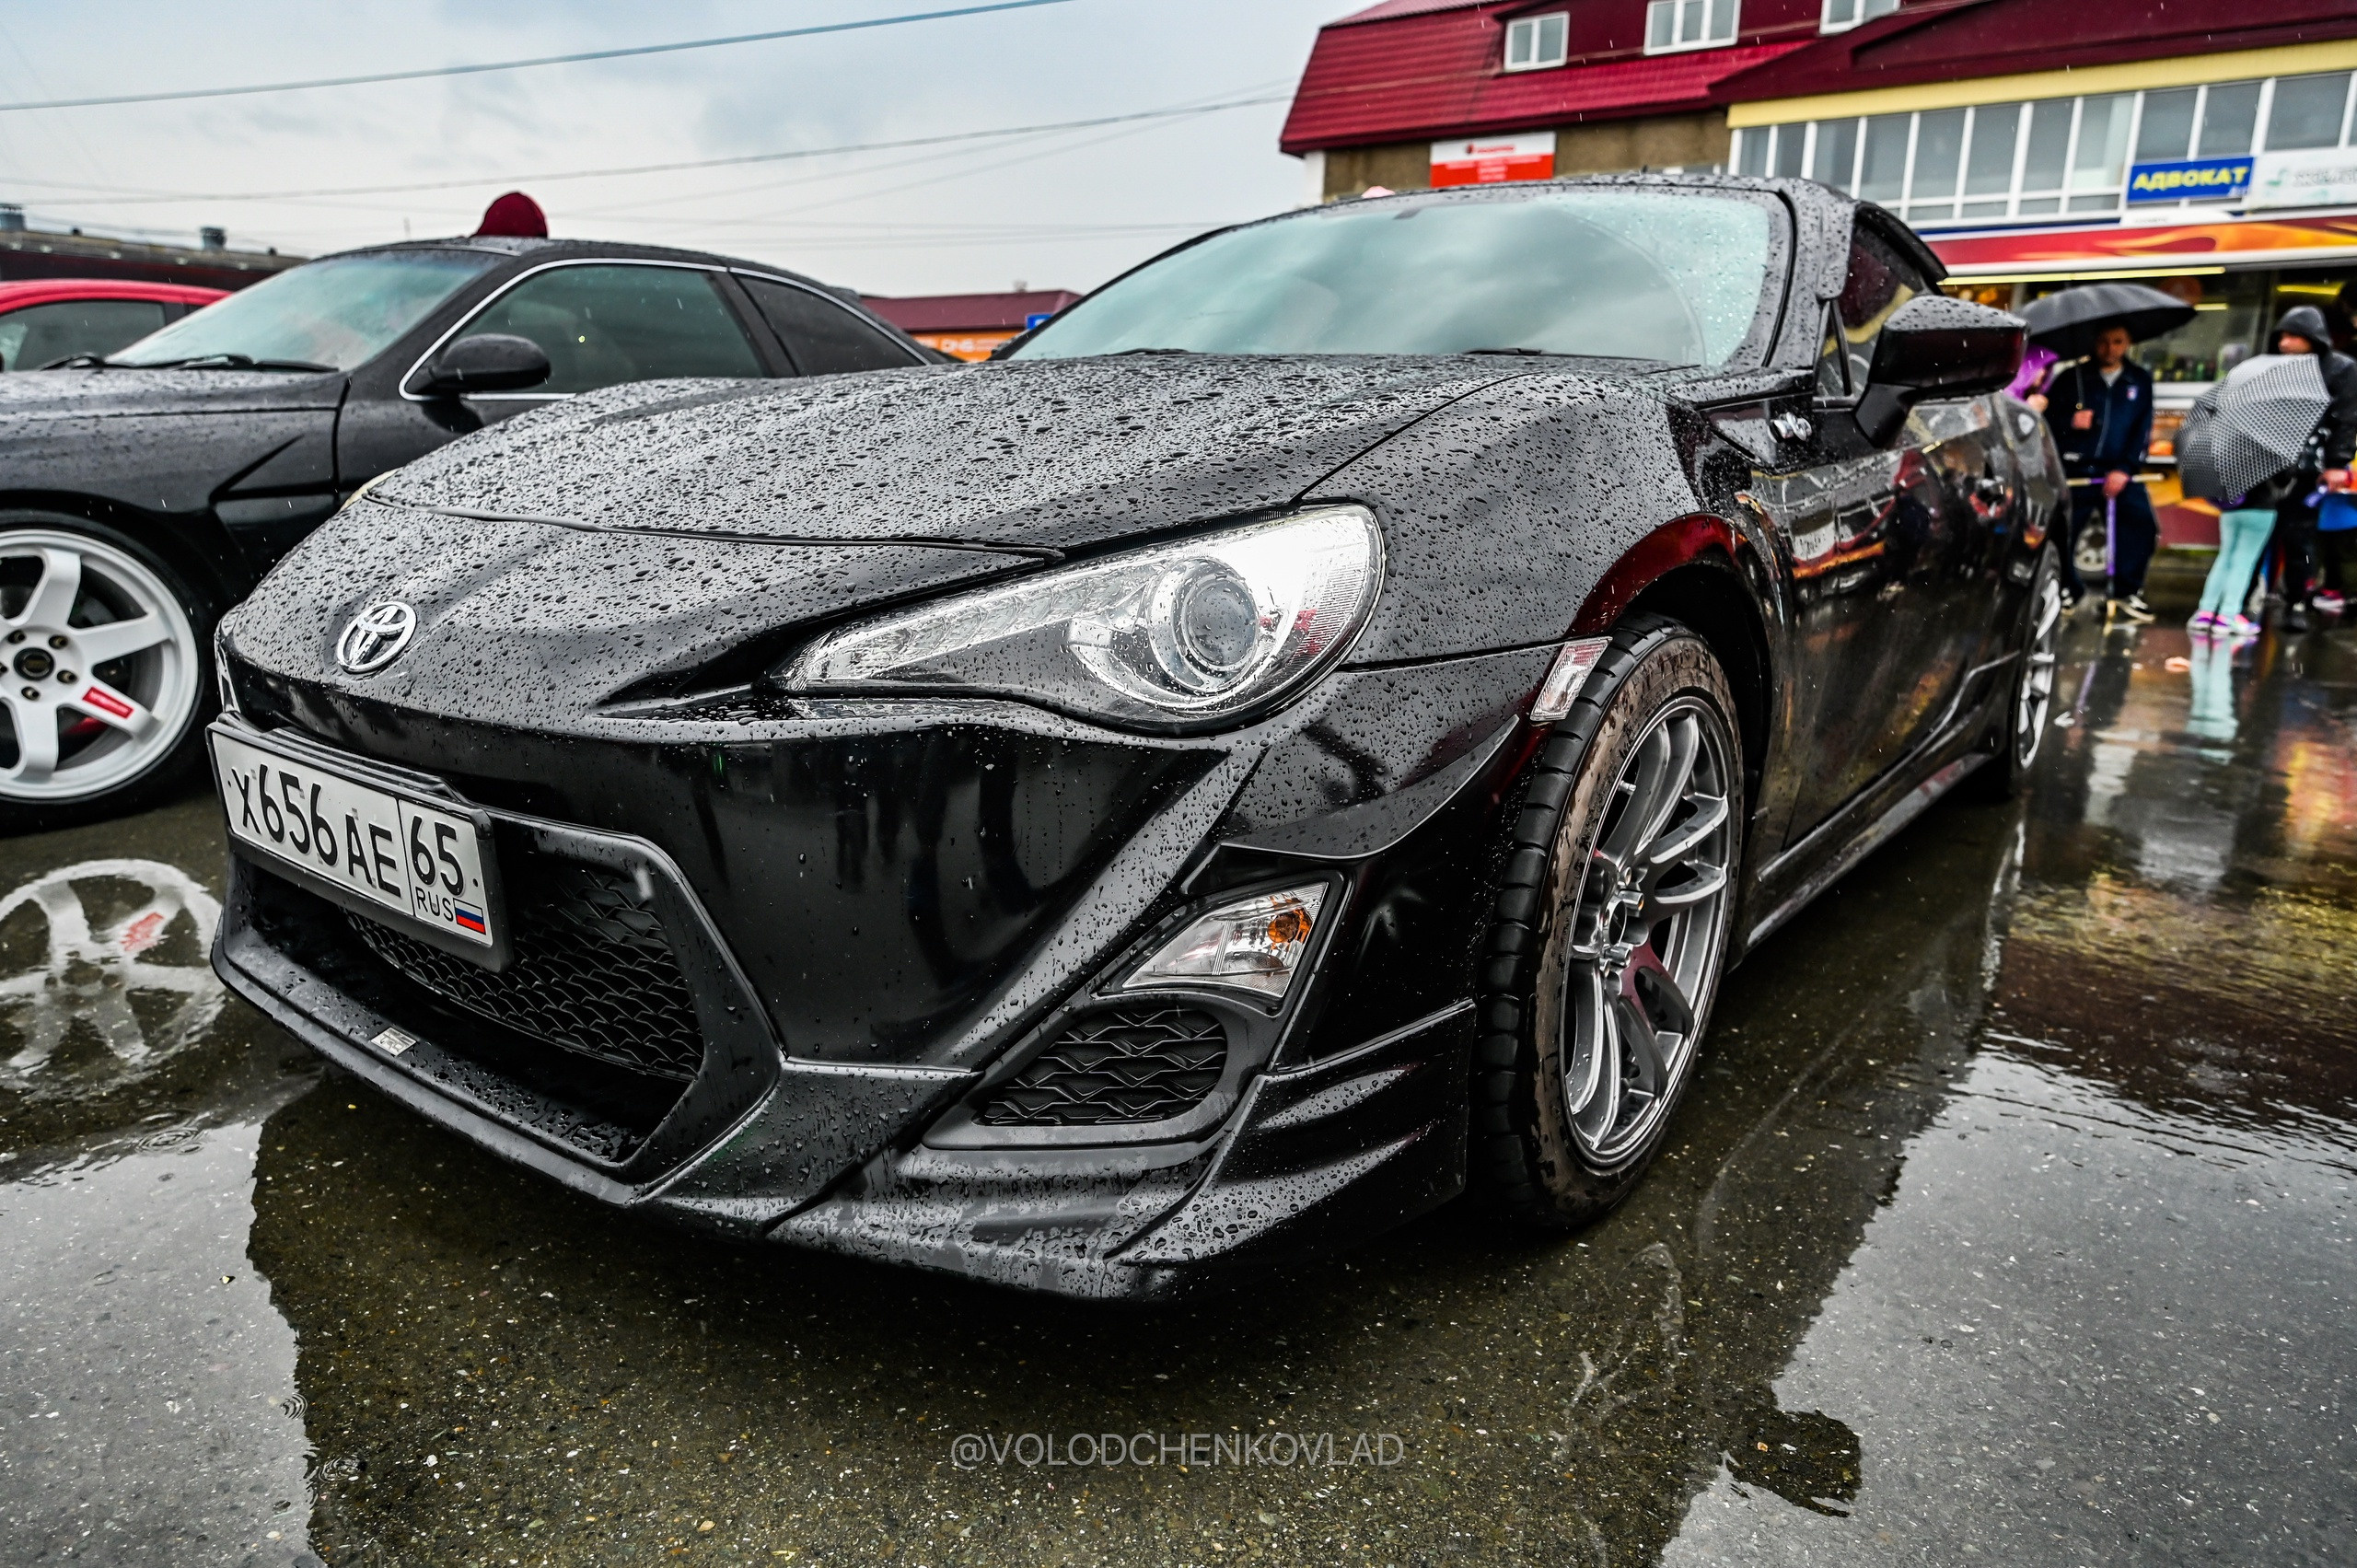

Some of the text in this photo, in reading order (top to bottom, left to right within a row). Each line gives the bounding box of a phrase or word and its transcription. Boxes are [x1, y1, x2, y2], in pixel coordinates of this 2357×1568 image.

[2132, 166, 2249, 192] АДВОКАТ
[411, 816, 463, 897] 65
[416, 887, 454, 922] RUS
